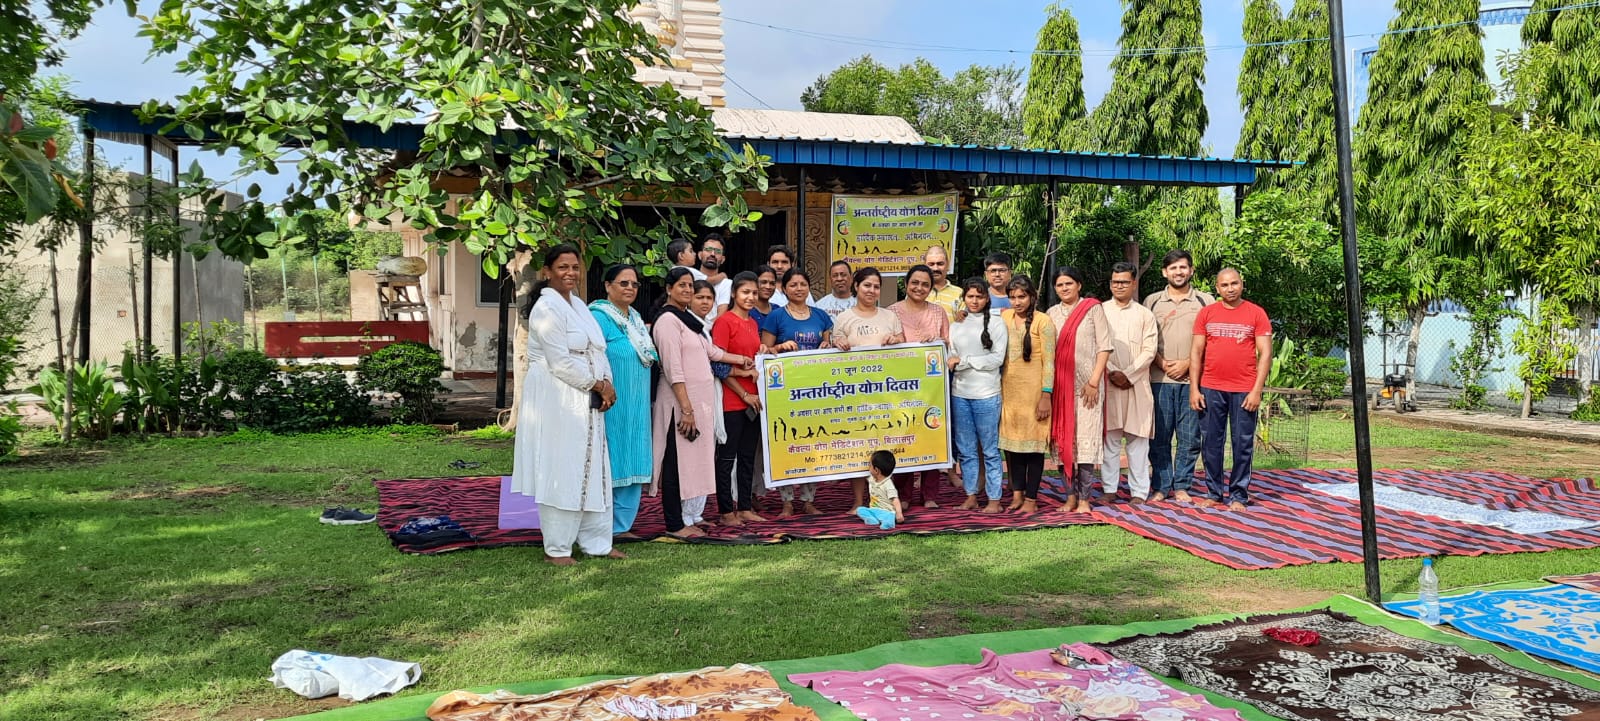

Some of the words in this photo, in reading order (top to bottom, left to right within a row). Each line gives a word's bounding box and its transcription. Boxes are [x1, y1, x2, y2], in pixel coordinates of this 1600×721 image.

[899, 206, 915, 216] योग
[917, 205, 939, 216] दिवस
[857, 325, 879, 336] Miss
[845, 367, 857, 376] जून
[861, 365, 883, 373] 2022
[790, 381, 855, 400] अन्तर्राष्ट्रीय
[859, 380, 883, 394] योग
[886, 377, 919, 392] दिवस
[797, 409, 812, 417] अवसर
[788, 444, 811, 453] कैवल्य
[814, 443, 828, 451] योग
[884, 435, 915, 446] बिलासपुर
